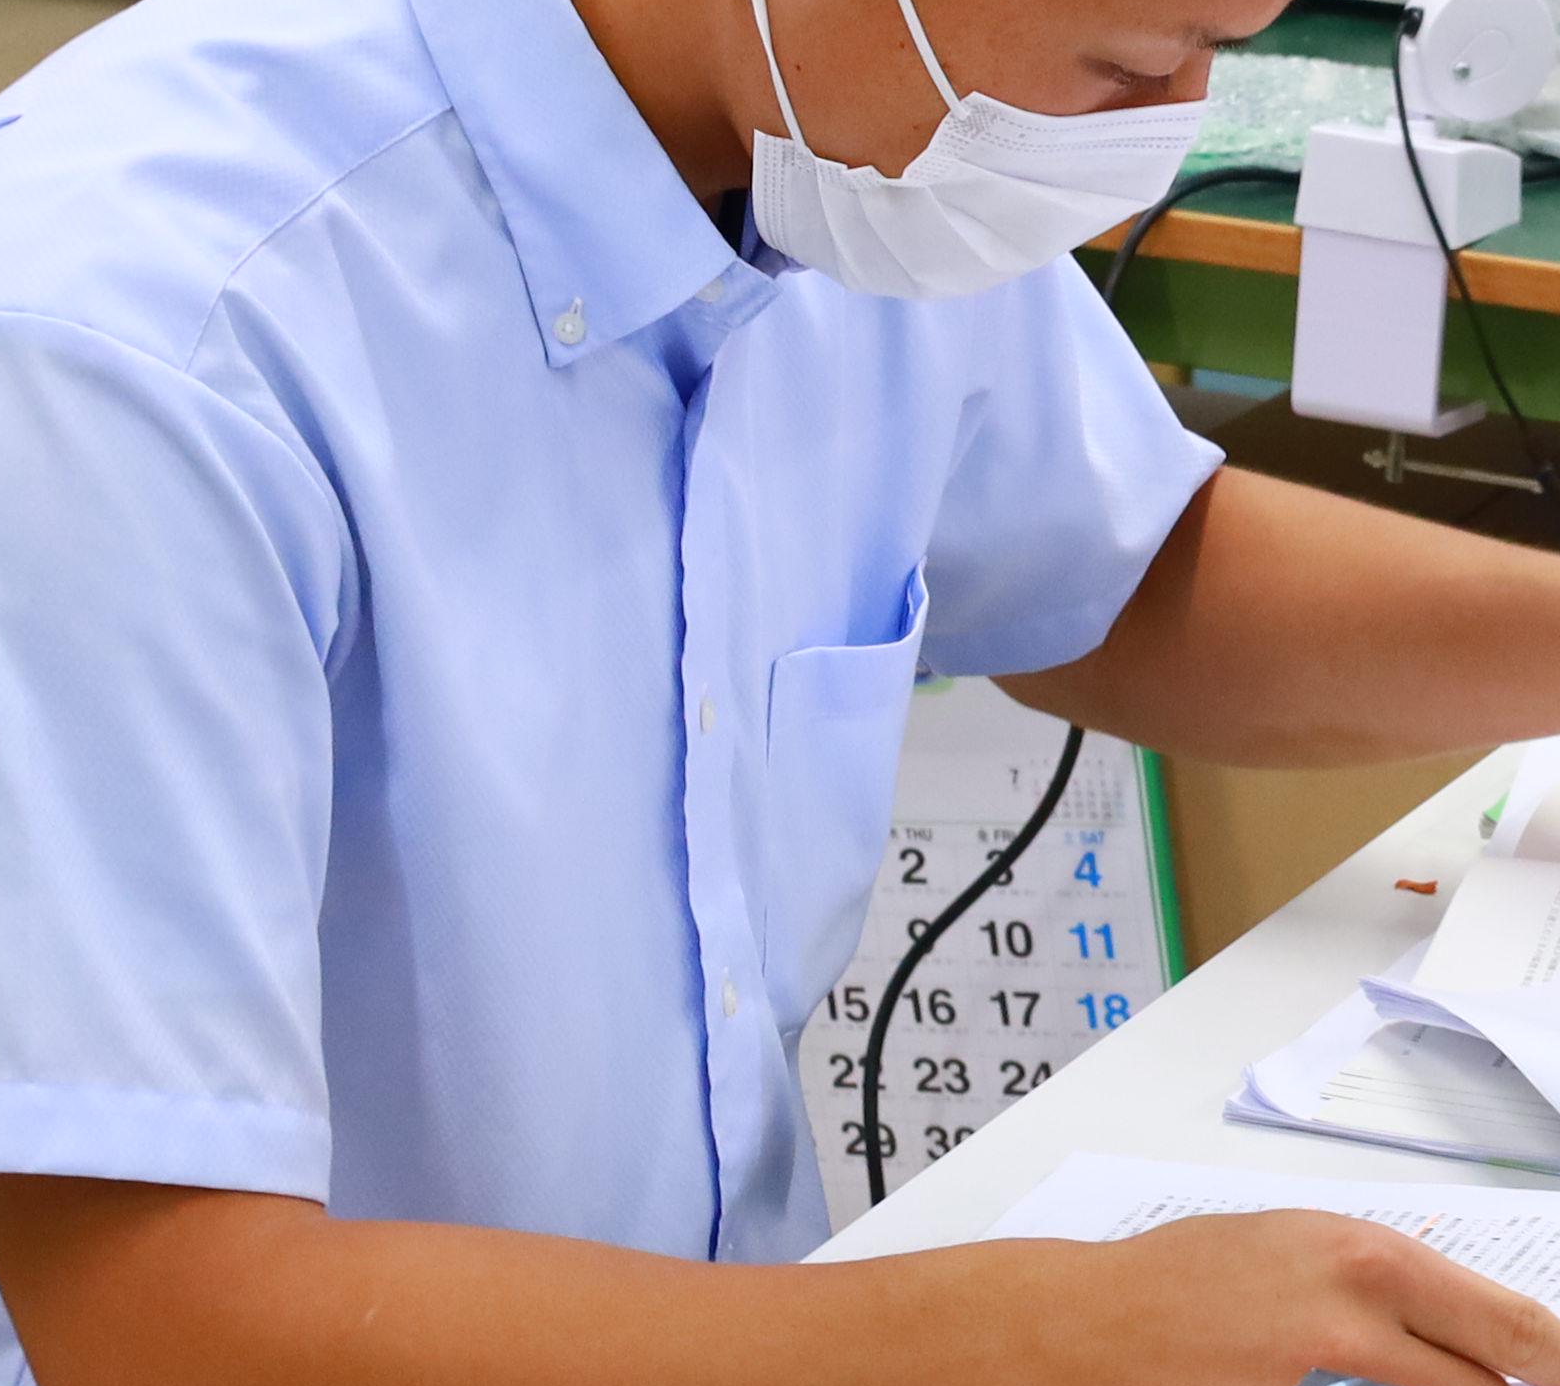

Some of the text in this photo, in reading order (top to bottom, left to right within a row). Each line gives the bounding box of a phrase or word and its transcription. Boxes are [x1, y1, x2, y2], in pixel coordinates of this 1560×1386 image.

[905, 828, 933, 842] THU
[1079, 831, 1106, 846] SAT
[899, 847, 928, 885] 2
[1073, 851, 1103, 888] 4
[979, 920, 1033, 958] 10
[1068, 921, 1116, 960] 11
[826, 986, 1131, 1031] 15 16 17 18
[912, 1057, 970, 1095] 23
